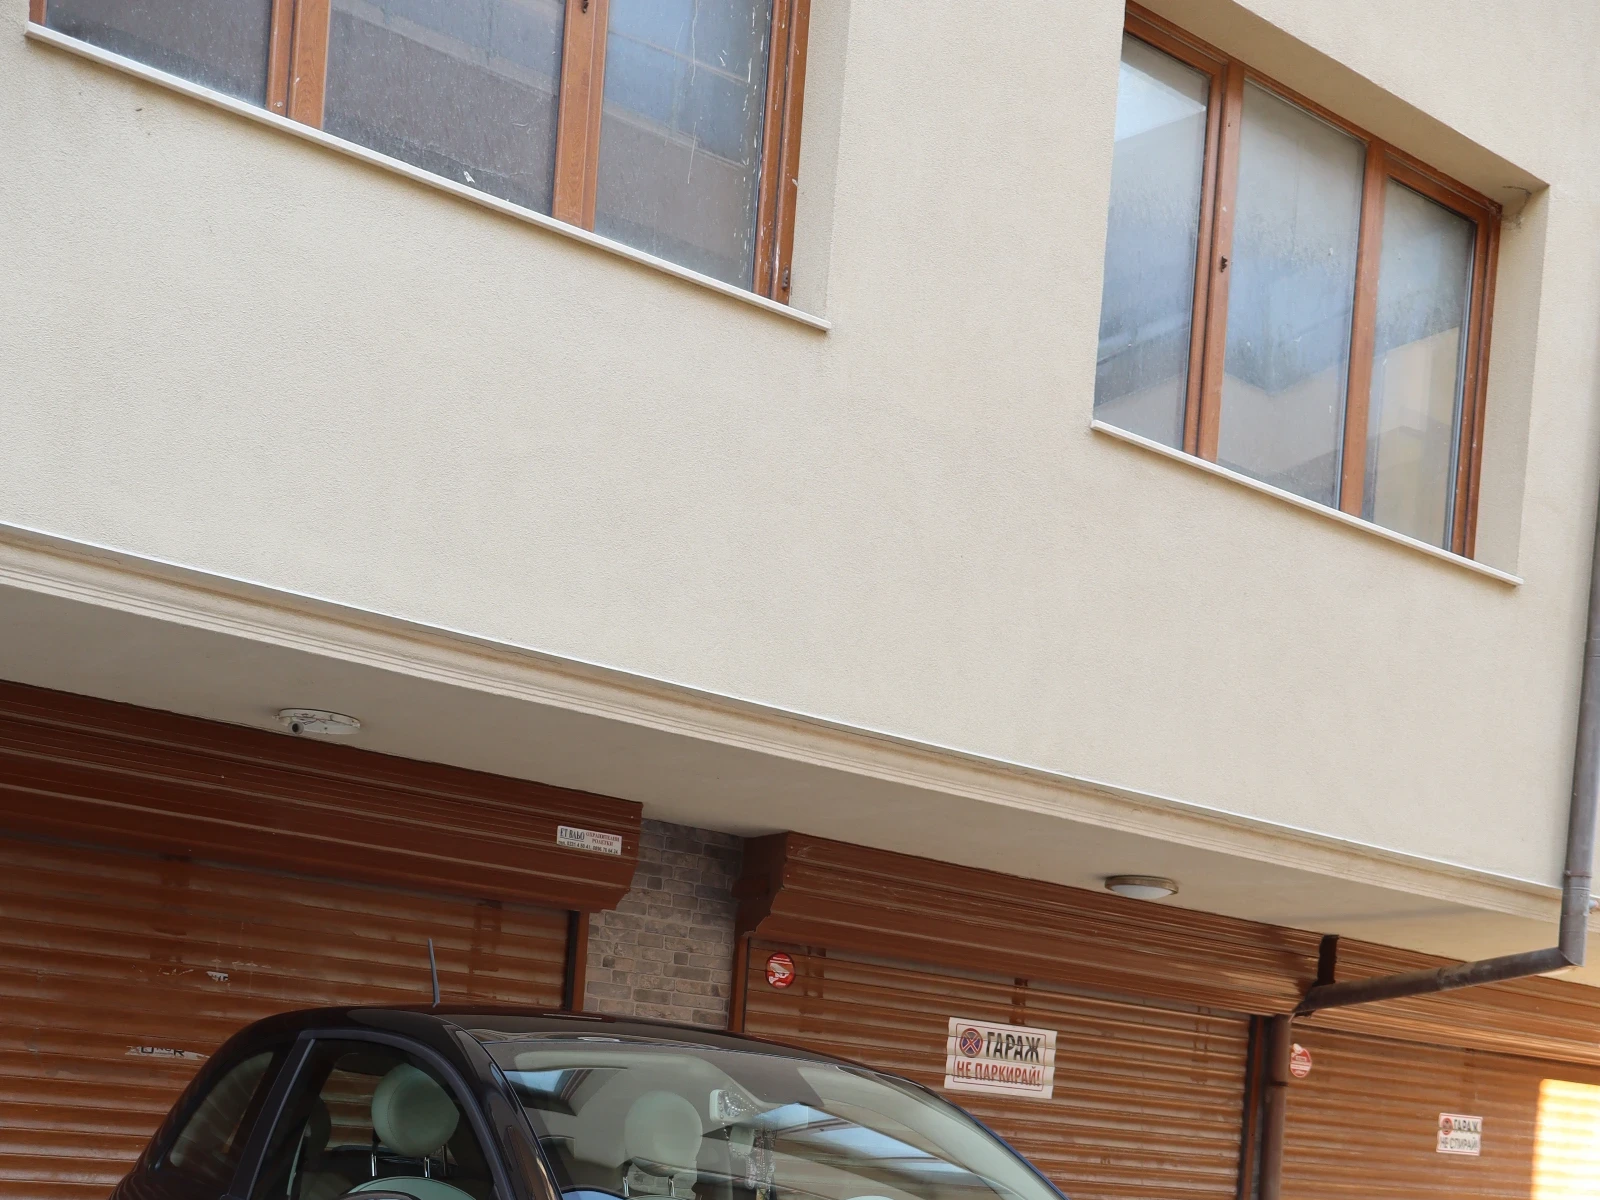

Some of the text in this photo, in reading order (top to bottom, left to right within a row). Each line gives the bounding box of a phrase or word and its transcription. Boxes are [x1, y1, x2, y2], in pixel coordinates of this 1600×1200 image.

[985, 1031, 1041, 1064] ГАРАЖ
[956, 1060, 1041, 1087] НЕ ПАРКИРАЙ!
